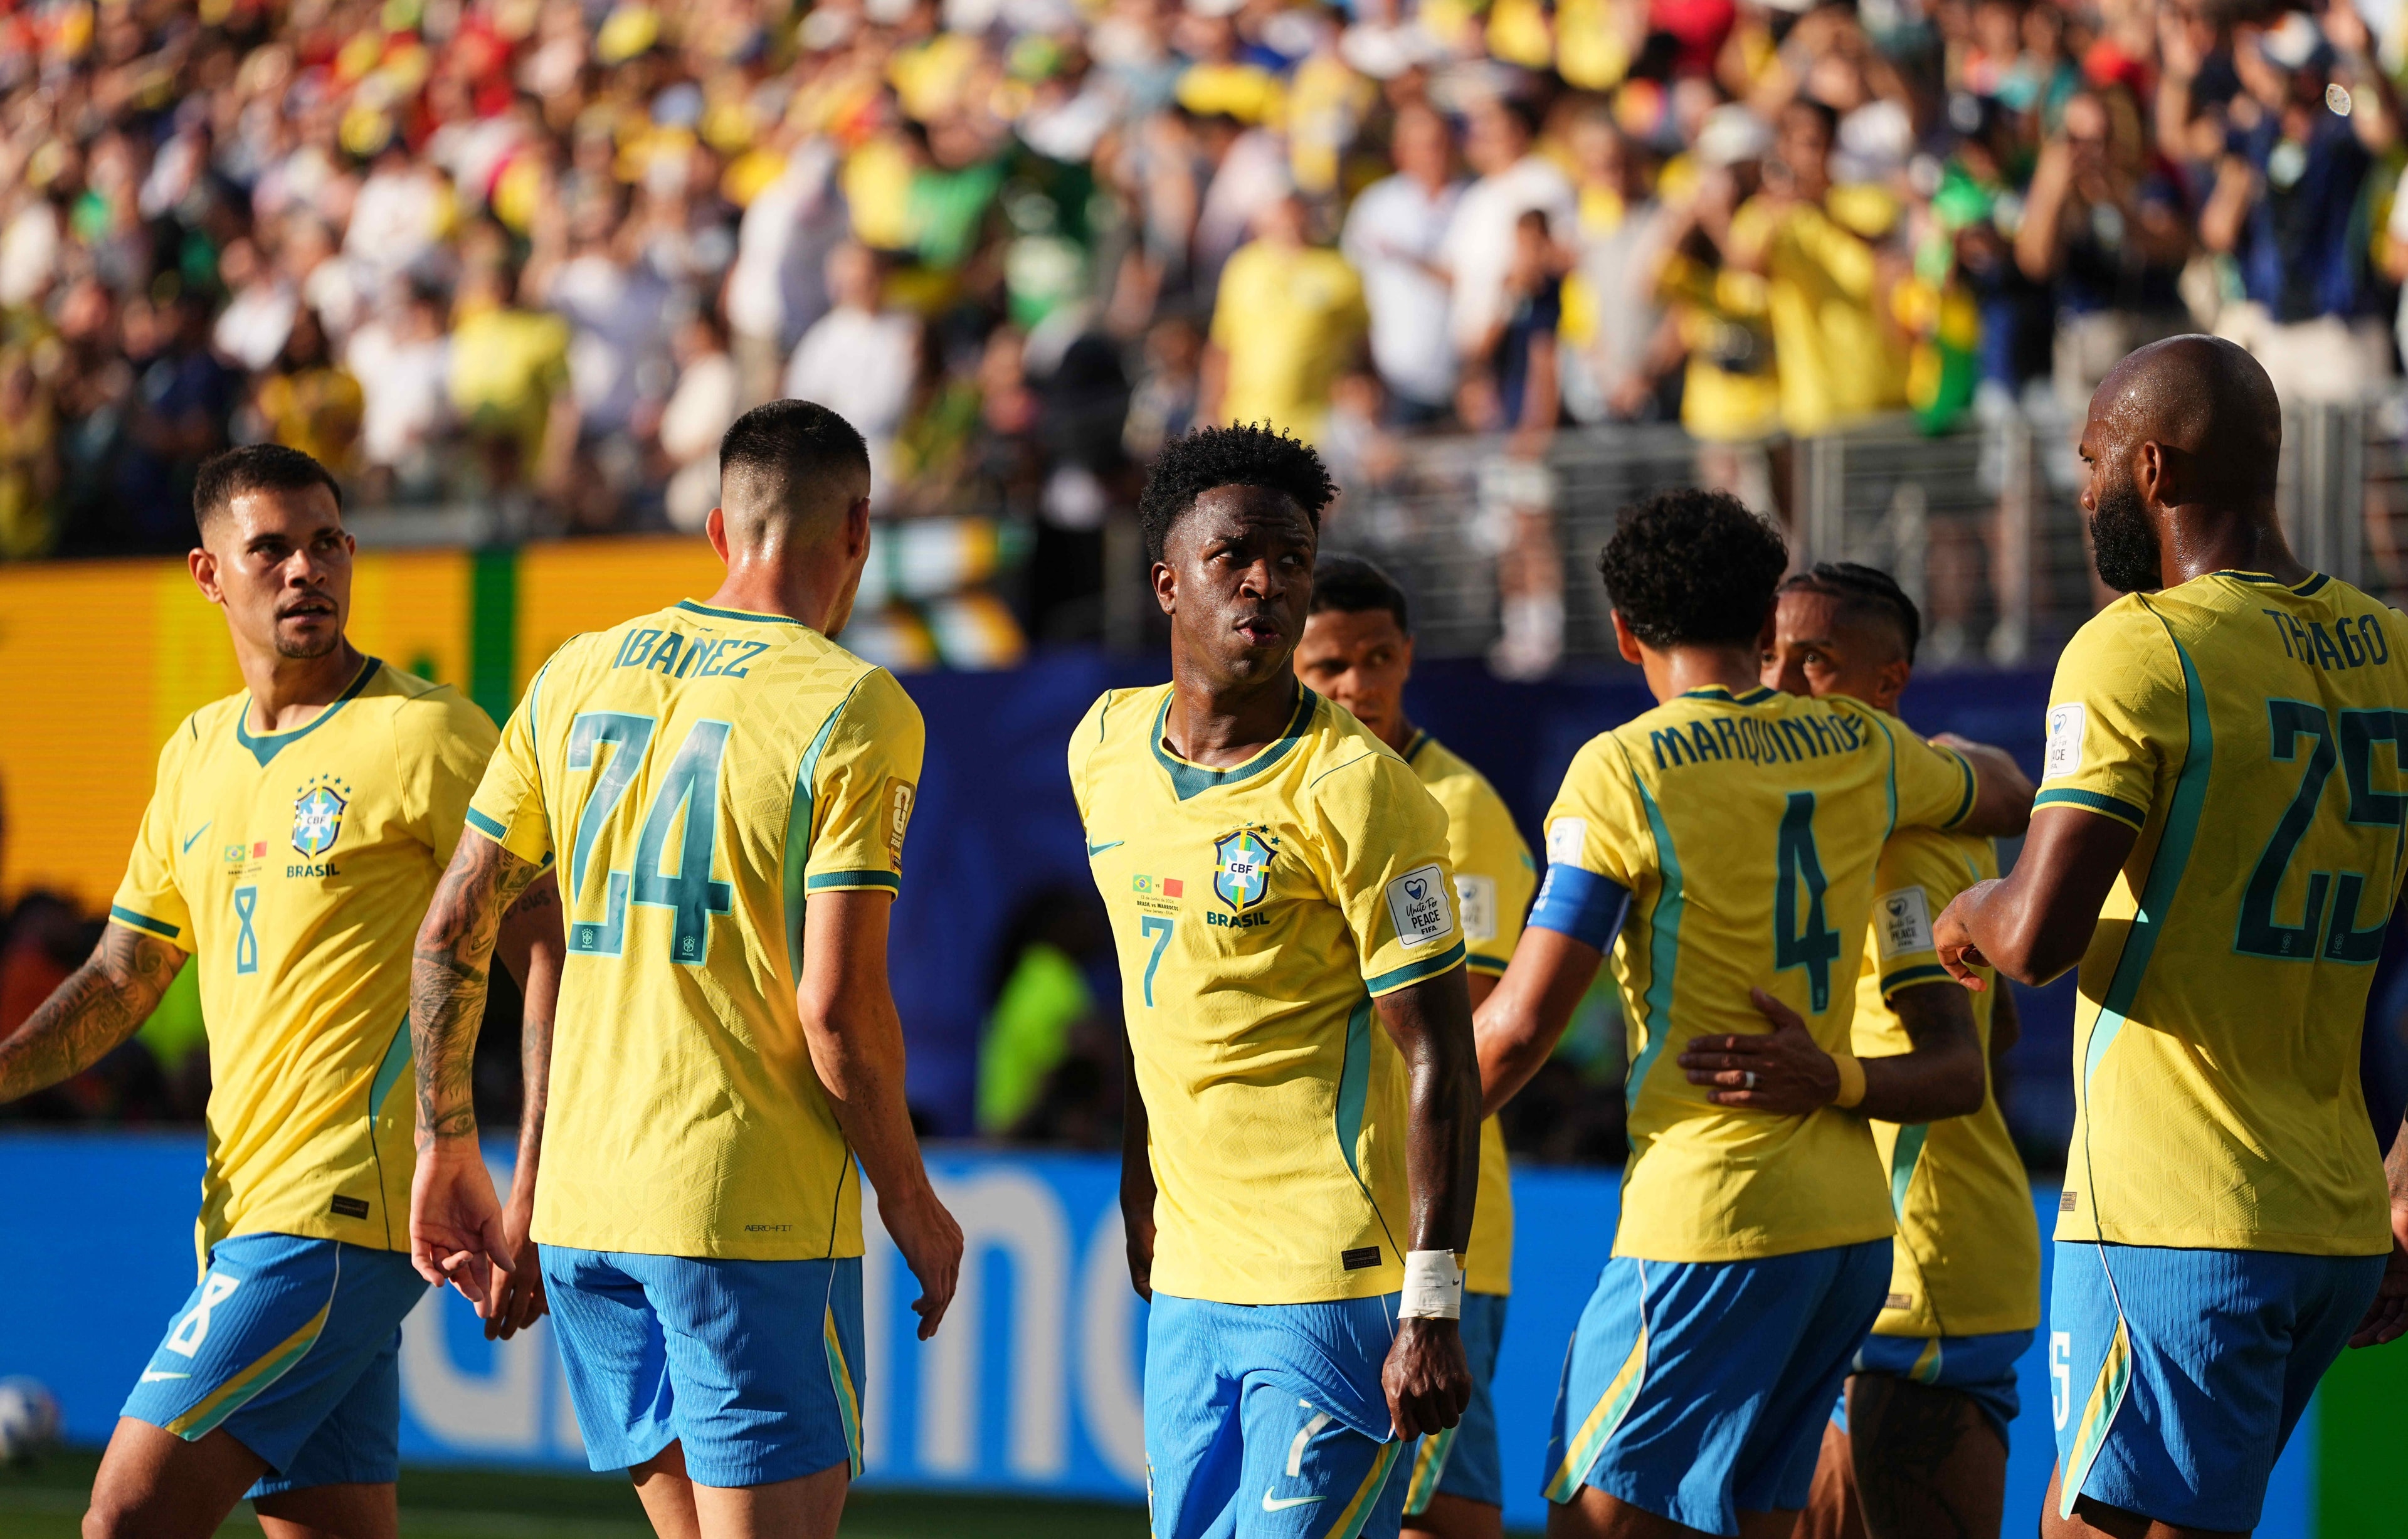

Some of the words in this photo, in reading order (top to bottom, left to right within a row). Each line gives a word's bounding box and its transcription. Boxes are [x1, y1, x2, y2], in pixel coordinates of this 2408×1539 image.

[612, 628, 771, 679] IBAÑEZ
[307, 816, 326, 825] CBF
[567, 711, 733, 966] 24
[2232, 697, 2408, 965] 25
[287, 863, 341, 878] BRASIL
[1230, 863, 1253, 874] CBF
[1157, 903, 1179, 911] MARROCOS
[1406, 901, 1427, 917] Unite
[1425, 897, 1438, 910] For
[1774, 790, 1841, 1015] 4
[1207, 911, 1270, 928] BRASIL
[1412, 909, 1440, 929] PEACE
[235, 886, 258, 976] 8
[1421, 925, 1437, 935] FIFA
[1141, 914, 1174, 1008] 7
[166, 1271, 241, 1359] 8
